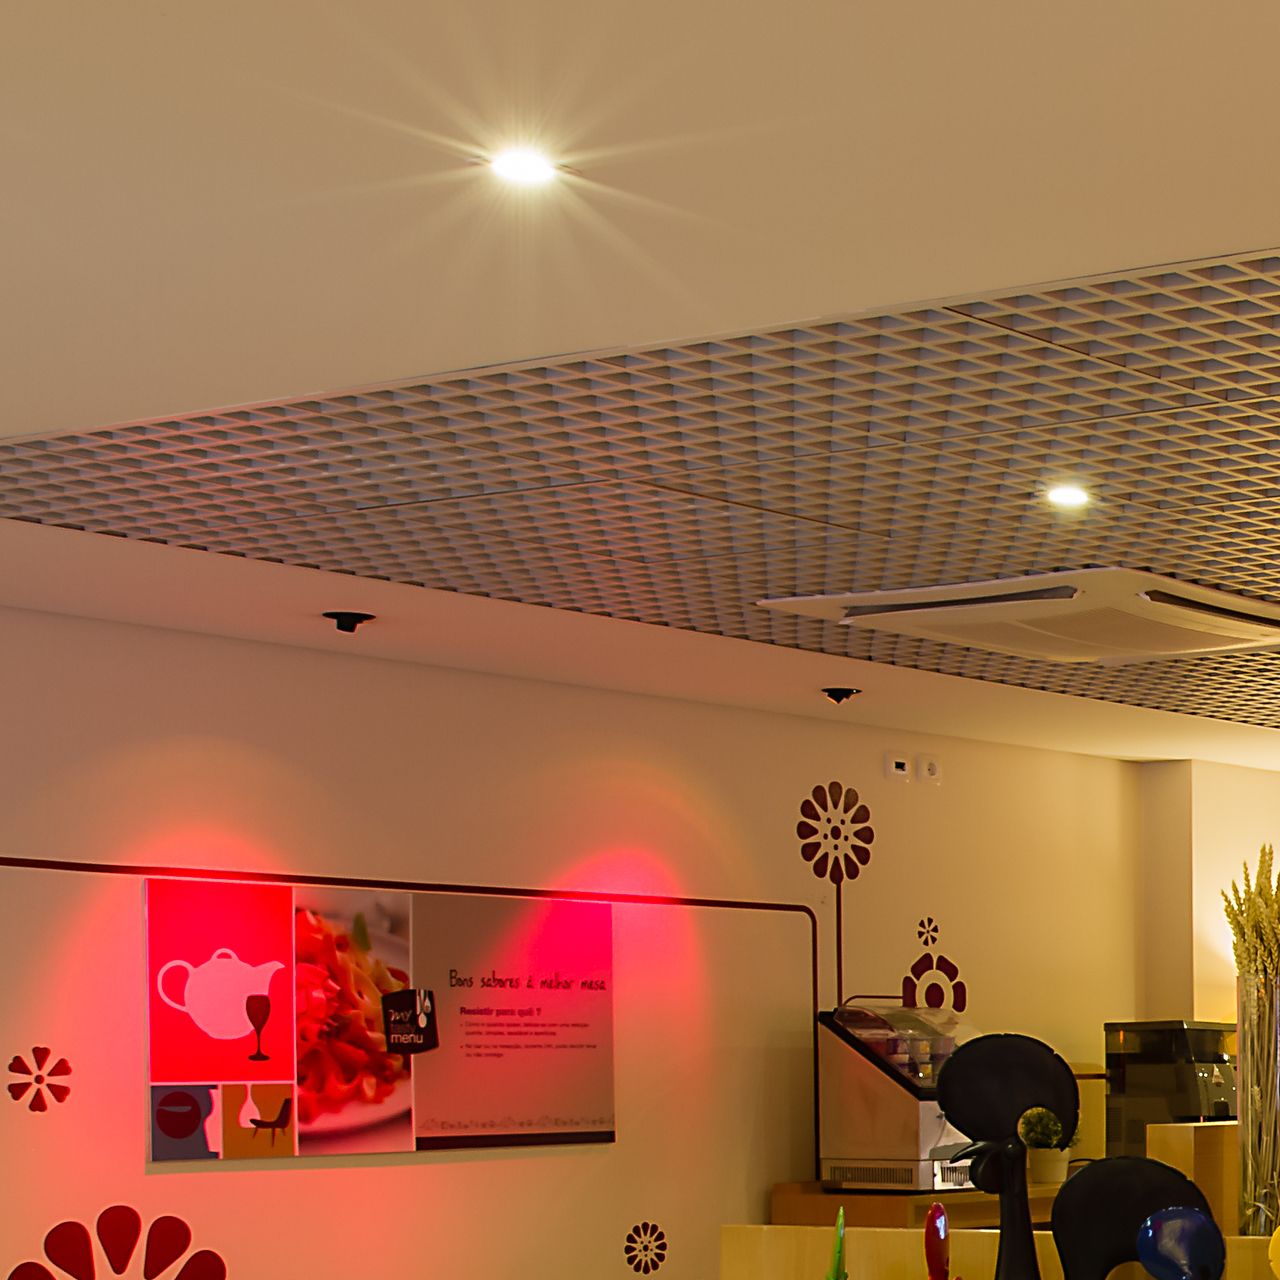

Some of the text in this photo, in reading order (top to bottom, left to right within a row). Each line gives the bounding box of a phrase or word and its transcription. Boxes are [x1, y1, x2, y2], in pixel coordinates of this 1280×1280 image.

[448, 969, 474, 988] Bons
[481, 970, 521, 989] sabores
[540, 971, 575, 989] melhor
[580, 978, 607, 991] mesa
[388, 1009, 413, 1022] my
[460, 1006, 494, 1016] Resistir
[496, 1008, 516, 1017] para
[390, 1034, 424, 1044] menu
